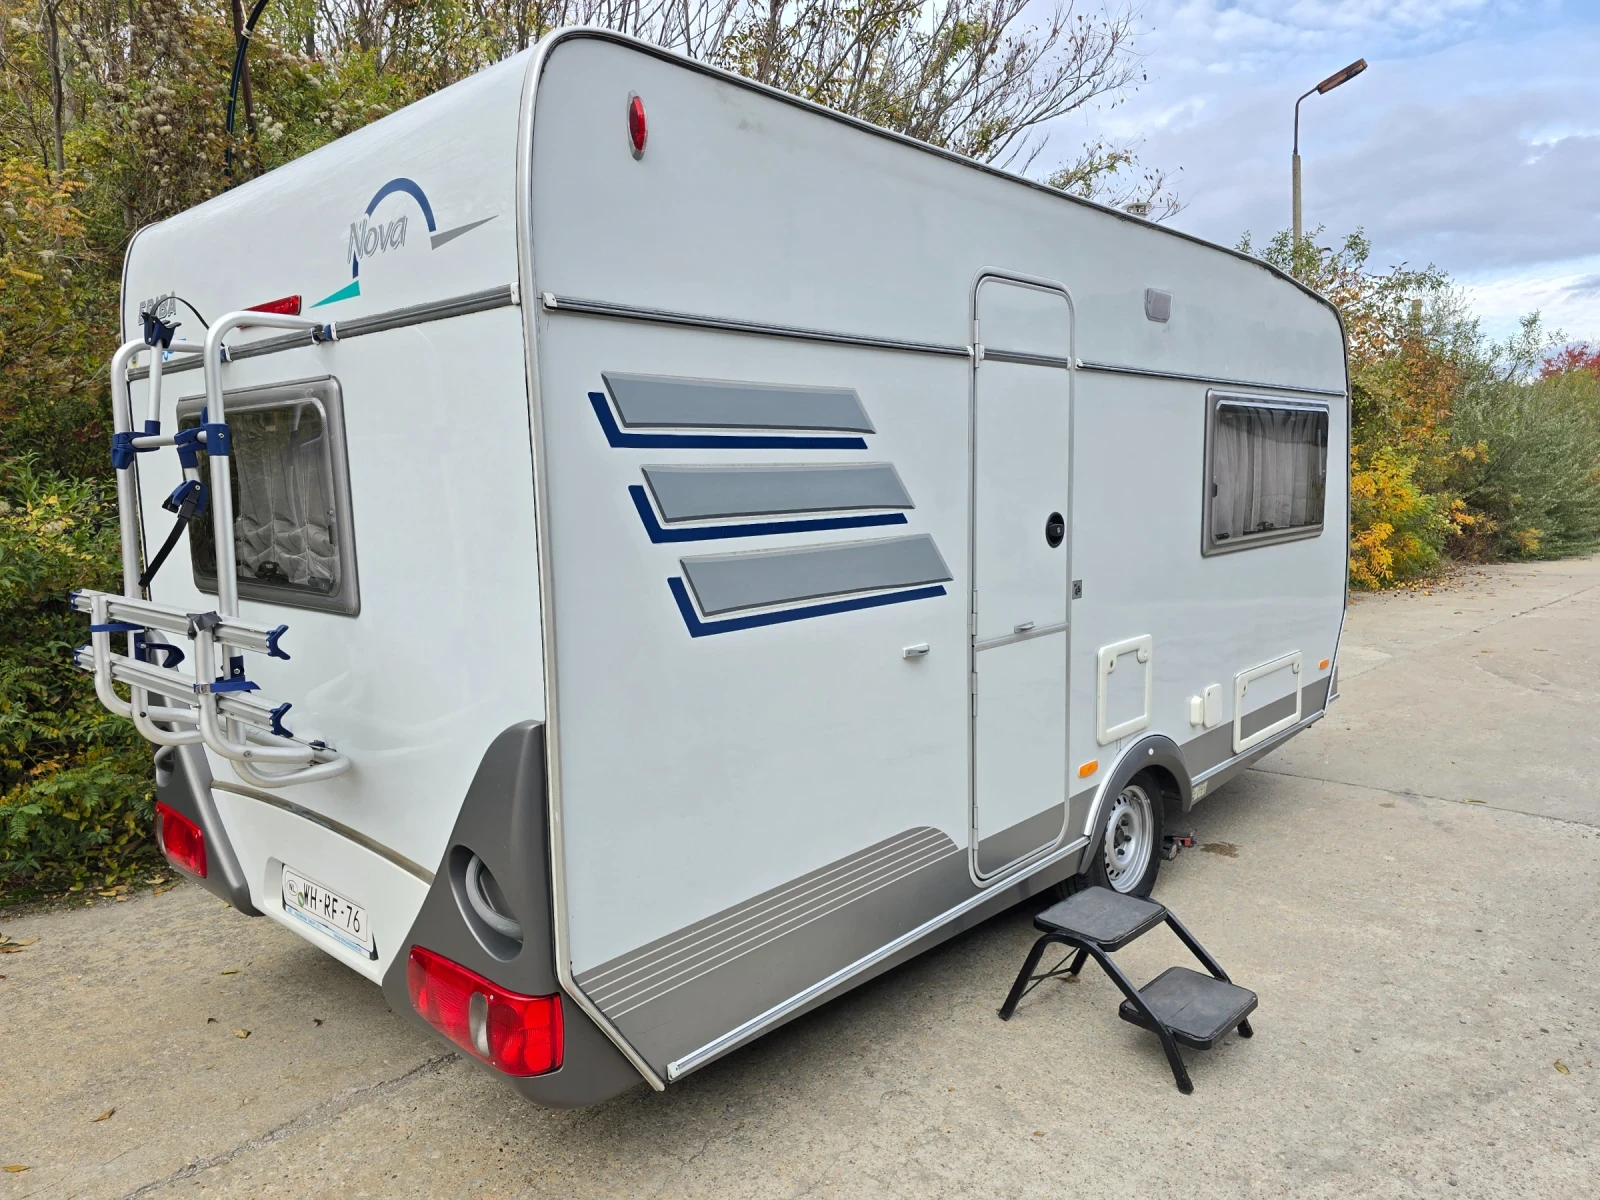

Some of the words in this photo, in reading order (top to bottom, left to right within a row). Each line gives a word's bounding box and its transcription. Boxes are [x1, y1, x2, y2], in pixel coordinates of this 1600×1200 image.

[347, 215, 408, 264] Nova
[288, 882, 296, 893] NL
[303, 882, 361, 933] WH-RF-76
